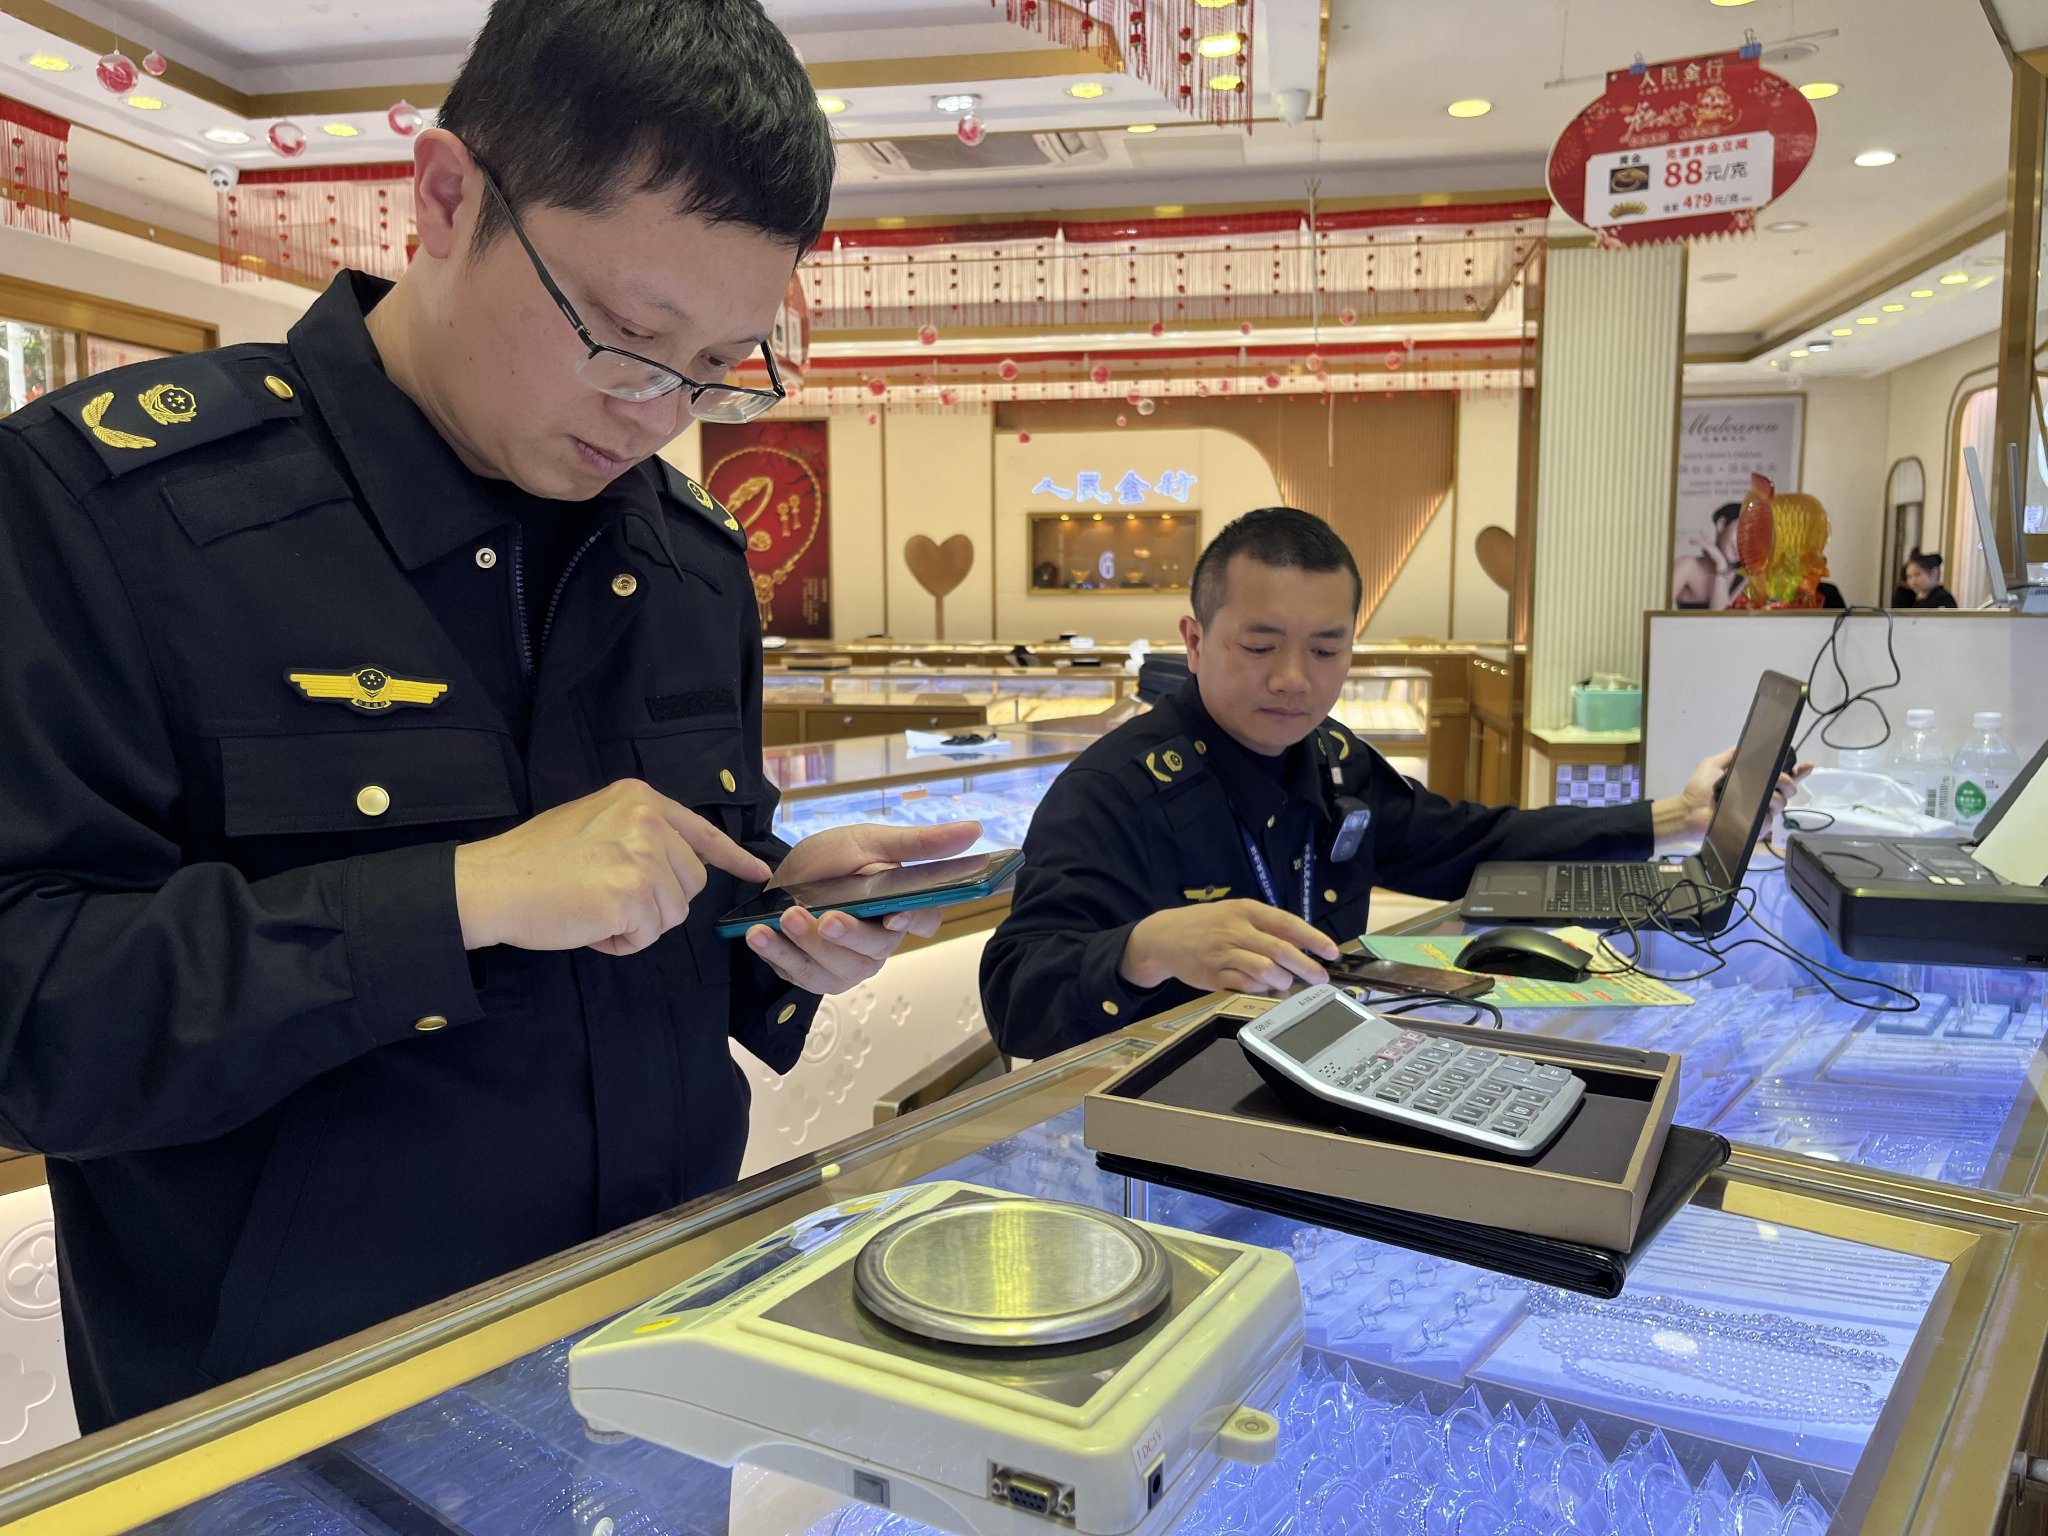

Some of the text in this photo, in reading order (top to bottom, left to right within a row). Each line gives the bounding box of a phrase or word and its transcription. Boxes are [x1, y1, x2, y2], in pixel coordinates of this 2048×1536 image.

[1638, 58, 1725, 90] 人民金行
[1032, 470, 1198, 505] 人民金行
